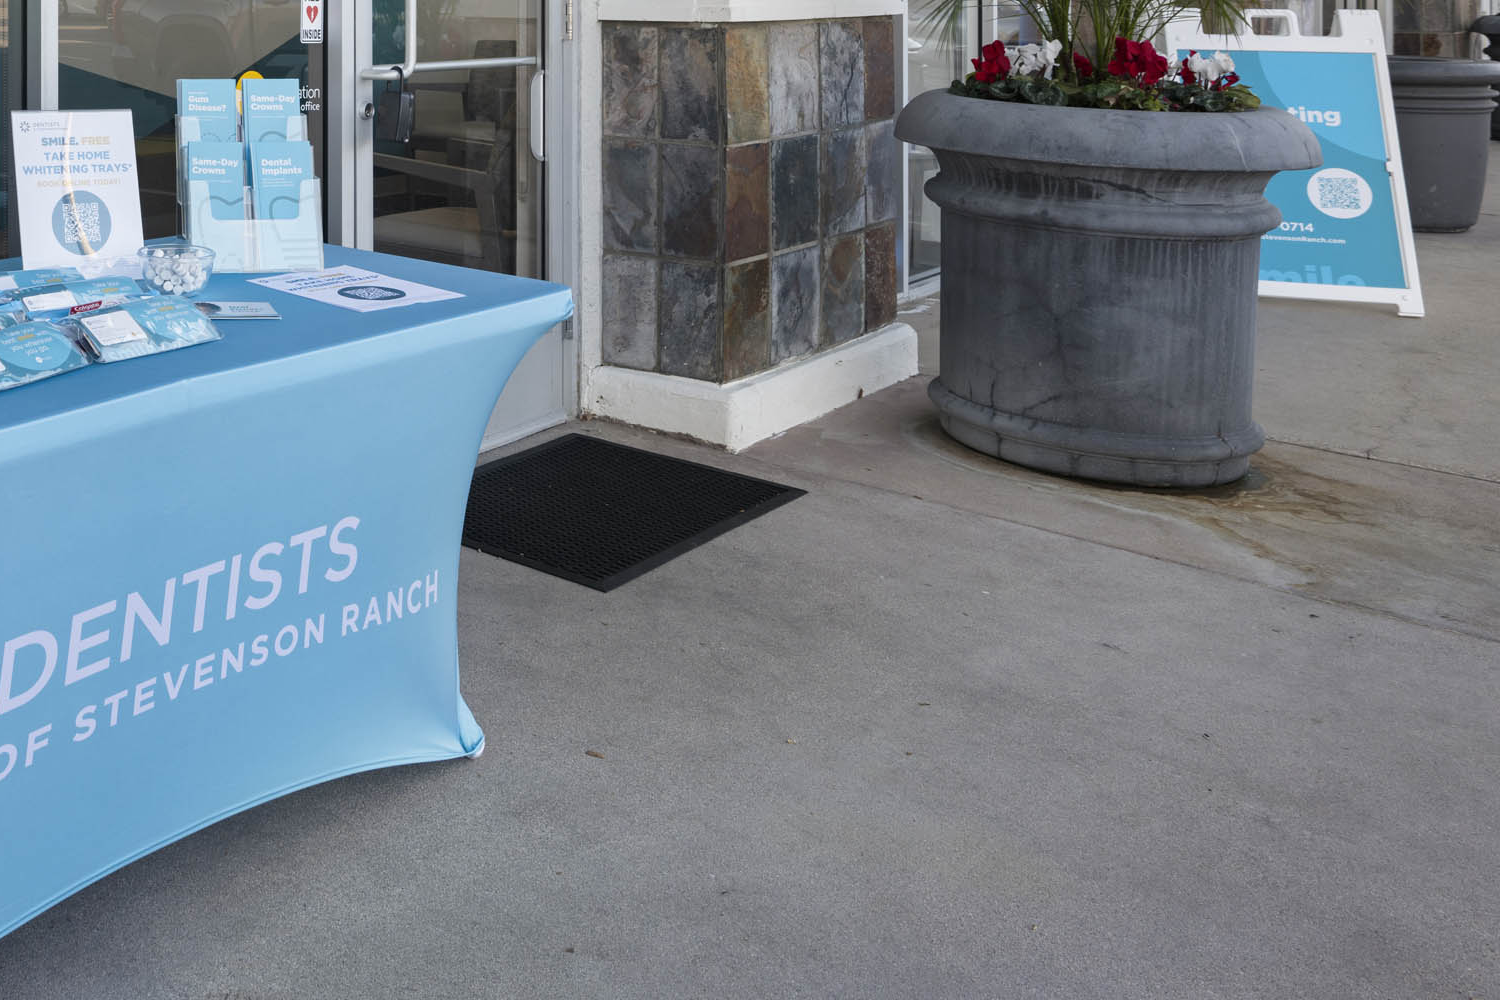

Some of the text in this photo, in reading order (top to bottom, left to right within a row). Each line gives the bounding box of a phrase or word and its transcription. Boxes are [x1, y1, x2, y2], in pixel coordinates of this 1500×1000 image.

[302, 29, 321, 40] INSIDE
[250, 95, 295, 104] Same-Day
[188, 104, 227, 112] Disease?
[250, 103, 284, 111] Crowns
[300, 101, 320, 111] office
[44, 151, 110, 161] TAKE HOME
[192, 158, 239, 168] Same-Day
[261, 158, 292, 167] Dental
[22, 164, 88, 175] WHITENING
[192, 166, 226, 175] Crowns
[261, 167, 302, 176] Implants
[74, 302, 101, 312] Colgate
[72, 610, 325, 743] STEVENSON
[341, 569, 440, 635] RANCH
